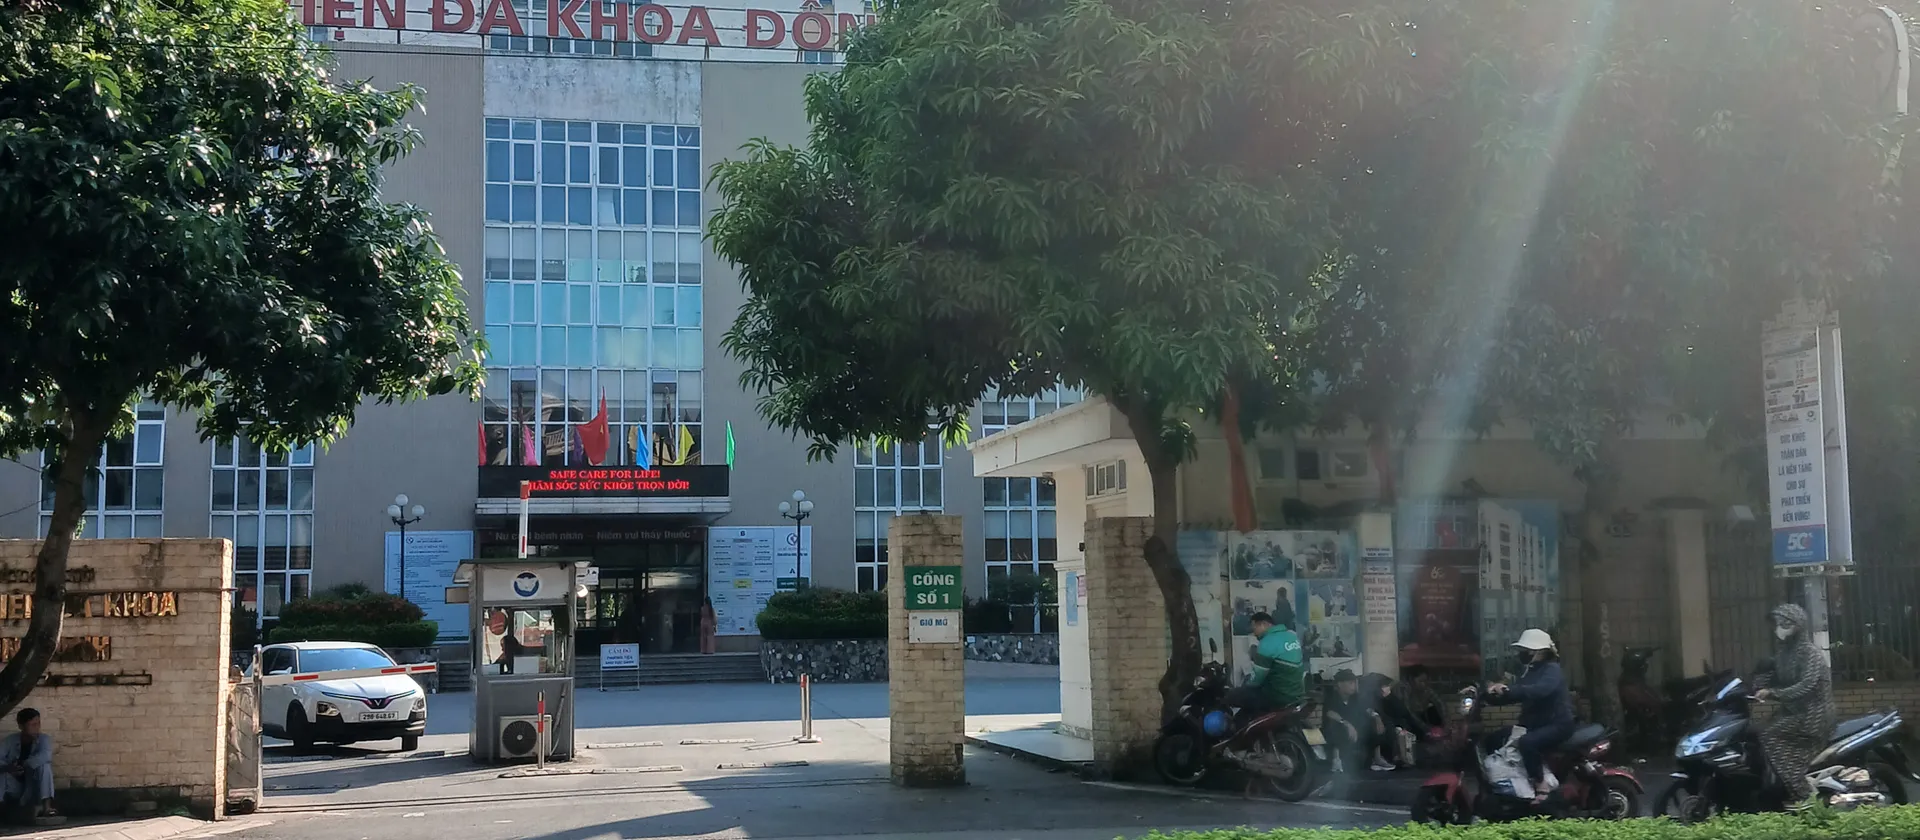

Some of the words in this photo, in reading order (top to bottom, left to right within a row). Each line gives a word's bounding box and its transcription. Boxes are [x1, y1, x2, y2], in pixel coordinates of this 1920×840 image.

[427, 0, 525, 36] ĐA
[546, 0, 723, 46] KHOA
[550, 470, 577, 479] SAFE
[579, 470, 607, 479] CARE
[610, 470, 632, 479] FOR
[634, 469, 661, 478] LIFE!
[528, 481, 554, 490] HĂM
[556, 480, 577, 490] SÓC
[580, 480, 602, 490] SỨC
[636, 482, 665, 492] TRỌN
[912, 569, 955, 586] CỔNG
[103, 591, 178, 617] KHOA
[916, 589, 937, 604] SỐ
[942, 593, 949, 604] 1
